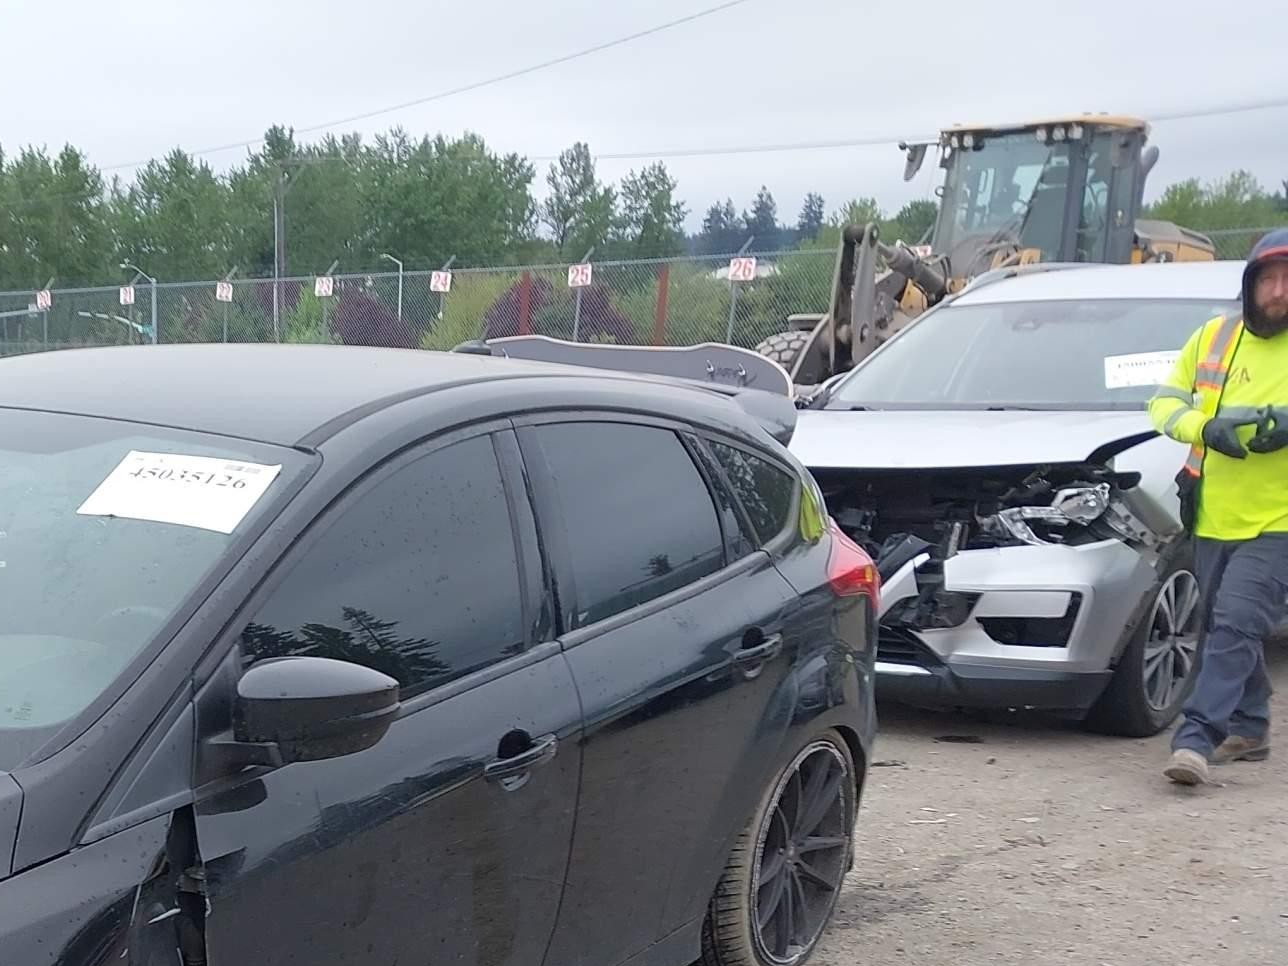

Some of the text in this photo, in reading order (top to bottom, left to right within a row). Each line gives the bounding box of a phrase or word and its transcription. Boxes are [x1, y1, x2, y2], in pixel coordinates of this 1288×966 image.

[571, 267, 589, 284] 25
[733, 260, 753, 277] 26
[433, 272, 449, 290] 24
